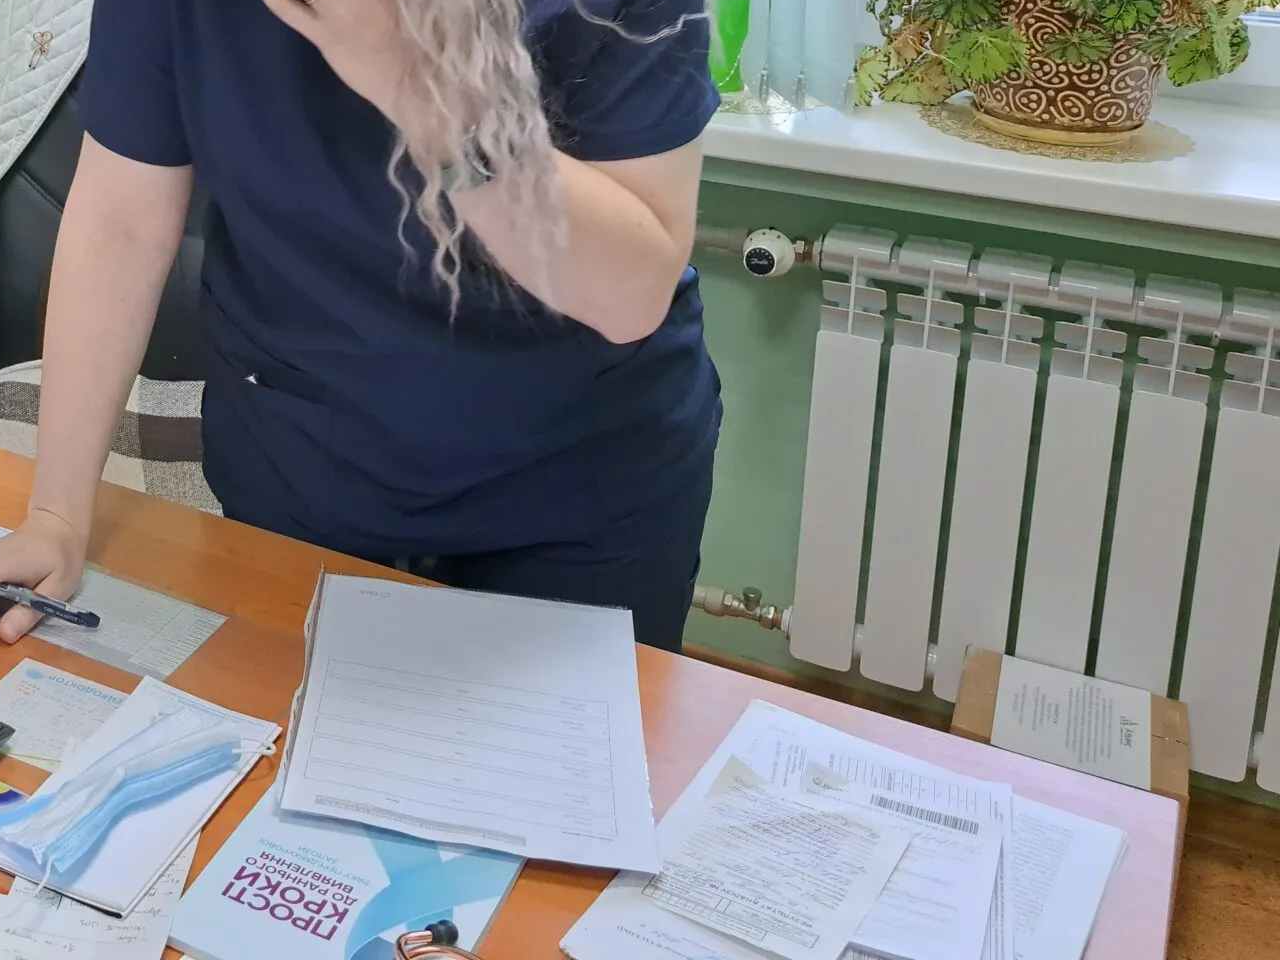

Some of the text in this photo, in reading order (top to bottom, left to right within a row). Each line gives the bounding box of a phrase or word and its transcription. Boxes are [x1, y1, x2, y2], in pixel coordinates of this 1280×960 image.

[233, 865, 349, 924] КРОКИ
[245, 856, 358, 907] ДО РАННЬОГО
[259, 850, 354, 894] ВИЯВЛЕННЯ
[221, 881, 338, 941] ПРОСТІ
